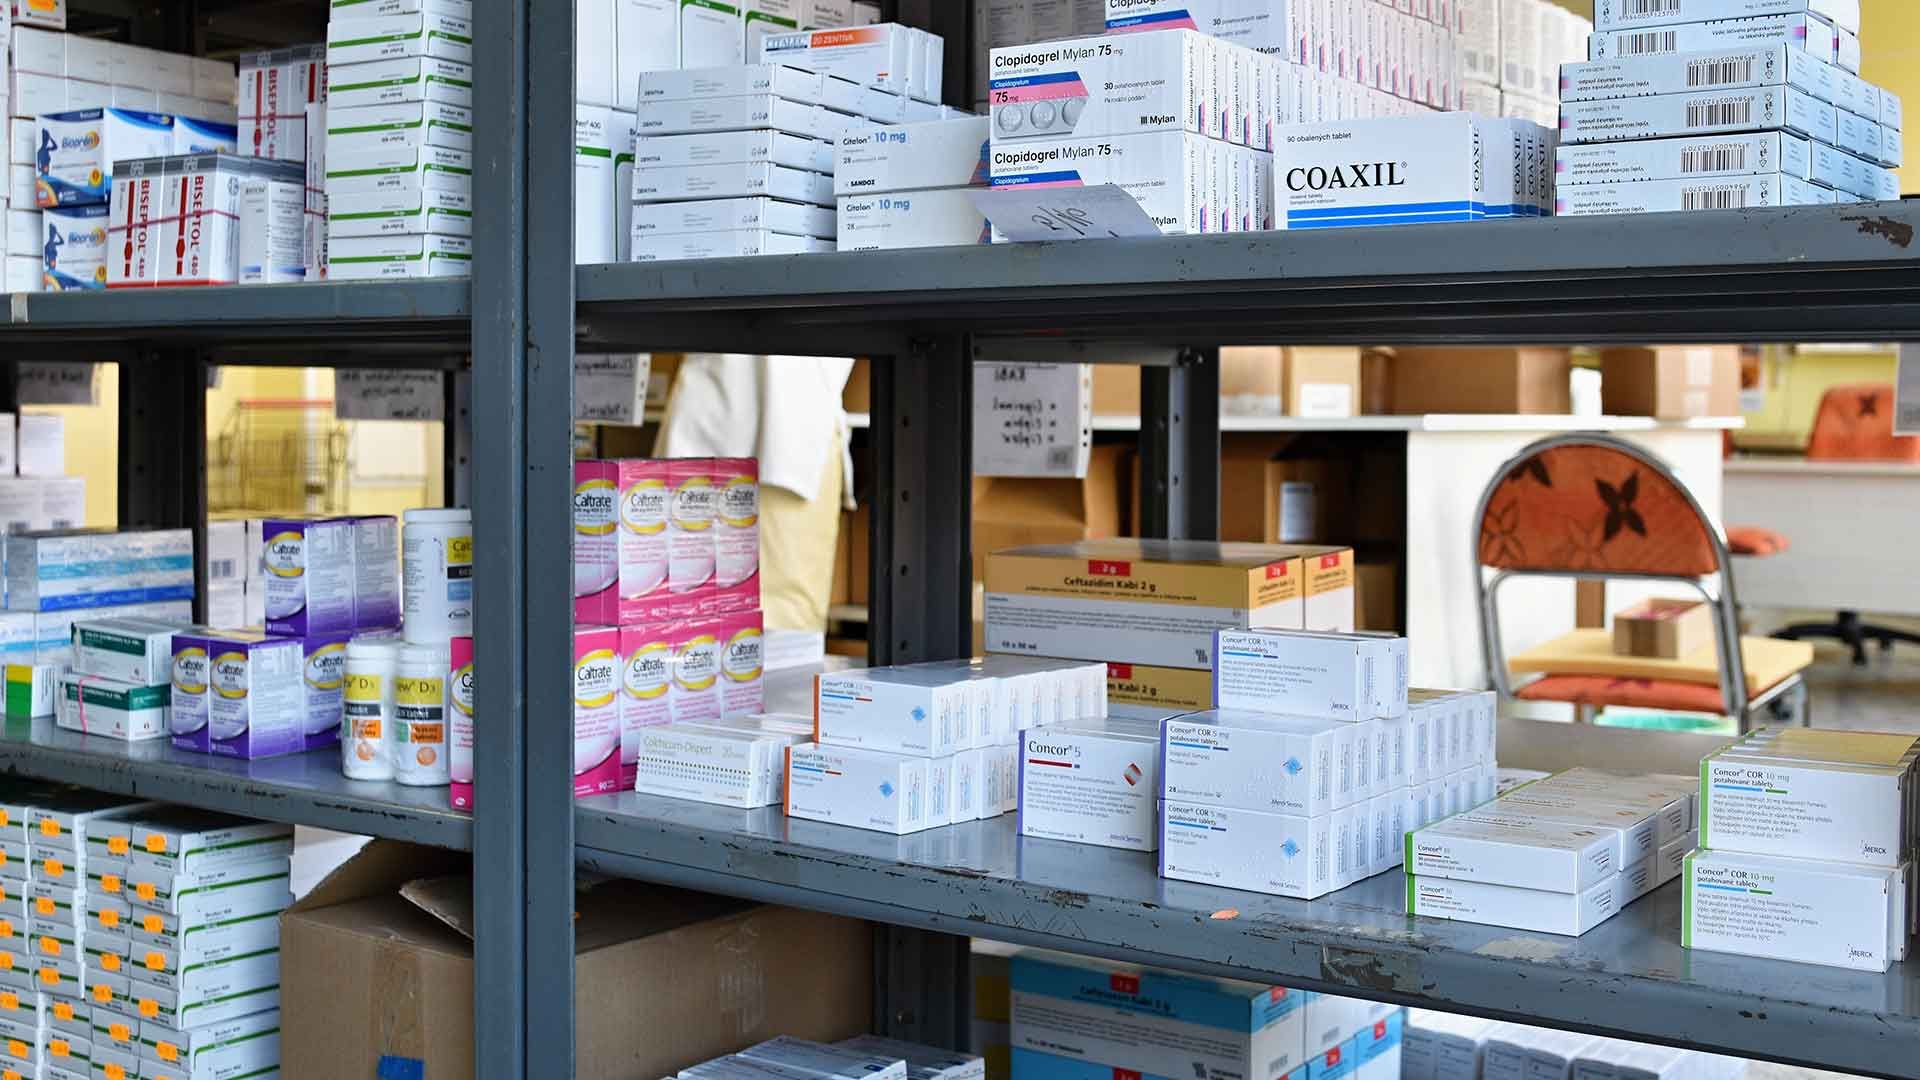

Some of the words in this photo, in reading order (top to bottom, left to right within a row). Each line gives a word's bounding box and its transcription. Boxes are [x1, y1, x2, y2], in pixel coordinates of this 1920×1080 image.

[1213, 18, 1222, 26] 30
[995, 50, 1060, 68] Clopidogrel
[1062, 48, 1095, 62] Mylan
[1098, 44, 1112, 56] 75
[1114, 48, 1124, 56] mg
[1104, 82, 1114, 90] 30
[996, 92, 1008, 102] 75
[1150, 115, 1176, 126] Mylan
[875, 132, 886, 142] 10
[890, 132, 906, 143] mg
[1332, 132, 1352, 140] tablet
[994, 148, 1058, 166] Clopidogrel
[1062, 146, 1094, 160] Mylan
[1098, 144, 1112, 156] 75
[1474, 128, 1482, 192] COAXIL
[1514, 131, 1522, 196] COAXIL
[850, 179, 875, 187] SANDOZ
[879, 200, 888, 210] 10
[894, 200, 910, 210] mg
[138, 179, 150, 252] BISEPTOL
[191, 176, 204, 250] BISEPTOL
[1152, 216, 1177, 226] Mylan
[575, 492, 612, 508] Caltrate
[631, 493, 664, 508] Caltrate
[272, 543, 300, 556] Caltrate
[1116, 579, 1138, 590] Kabi
[178, 656, 204, 672] Caltrate
[217, 663, 244, 676] Caltrate
[578, 666, 612, 681] Caltrate
[1118, 682, 1140, 692] Kabi
[1198, 728, 1211, 736] COR
[1746, 770, 1764, 780] COR
[1196, 808, 1209, 816] COR
[1864, 845, 1887, 854] MERCK
[1730, 870, 1748, 880] COR
[1850, 949, 1873, 958] MERCK
